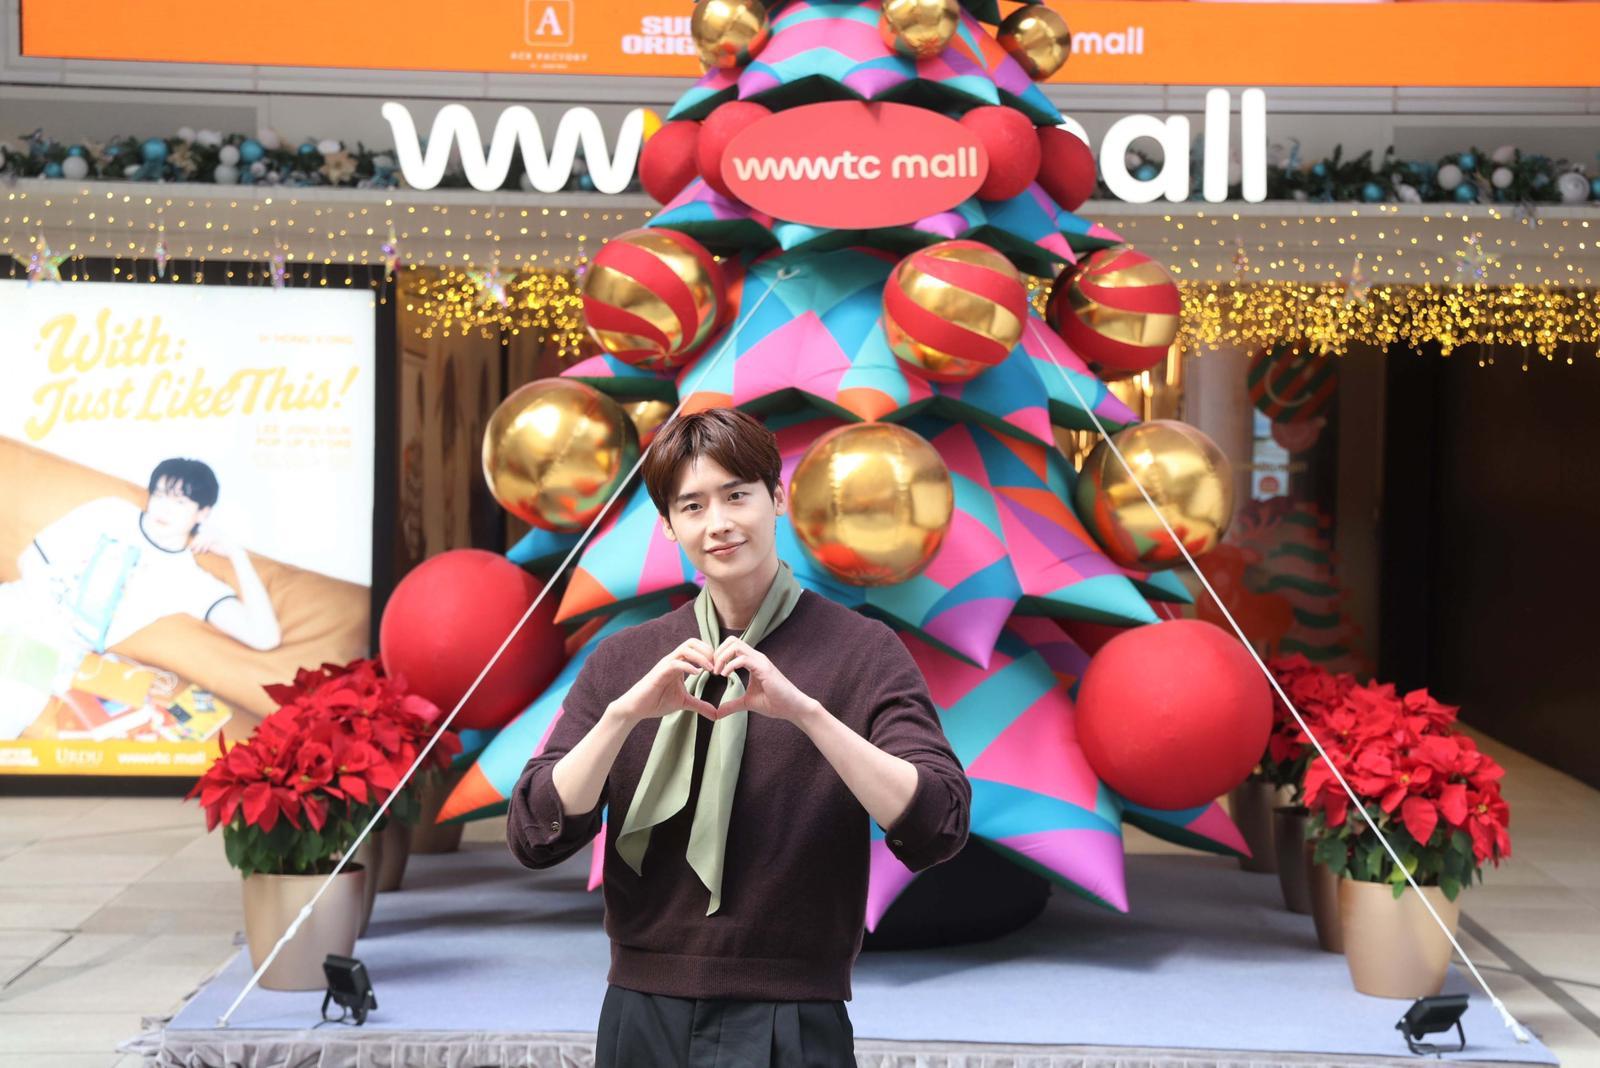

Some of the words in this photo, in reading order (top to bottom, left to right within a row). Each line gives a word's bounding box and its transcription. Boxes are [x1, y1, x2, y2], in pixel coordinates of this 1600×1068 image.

[1071, 26, 1144, 54] mall
[732, 151, 881, 181] wwwtc
[892, 147, 977, 179] mall
[1062, 88, 1267, 204] all
[24, 376, 135, 441] Just
